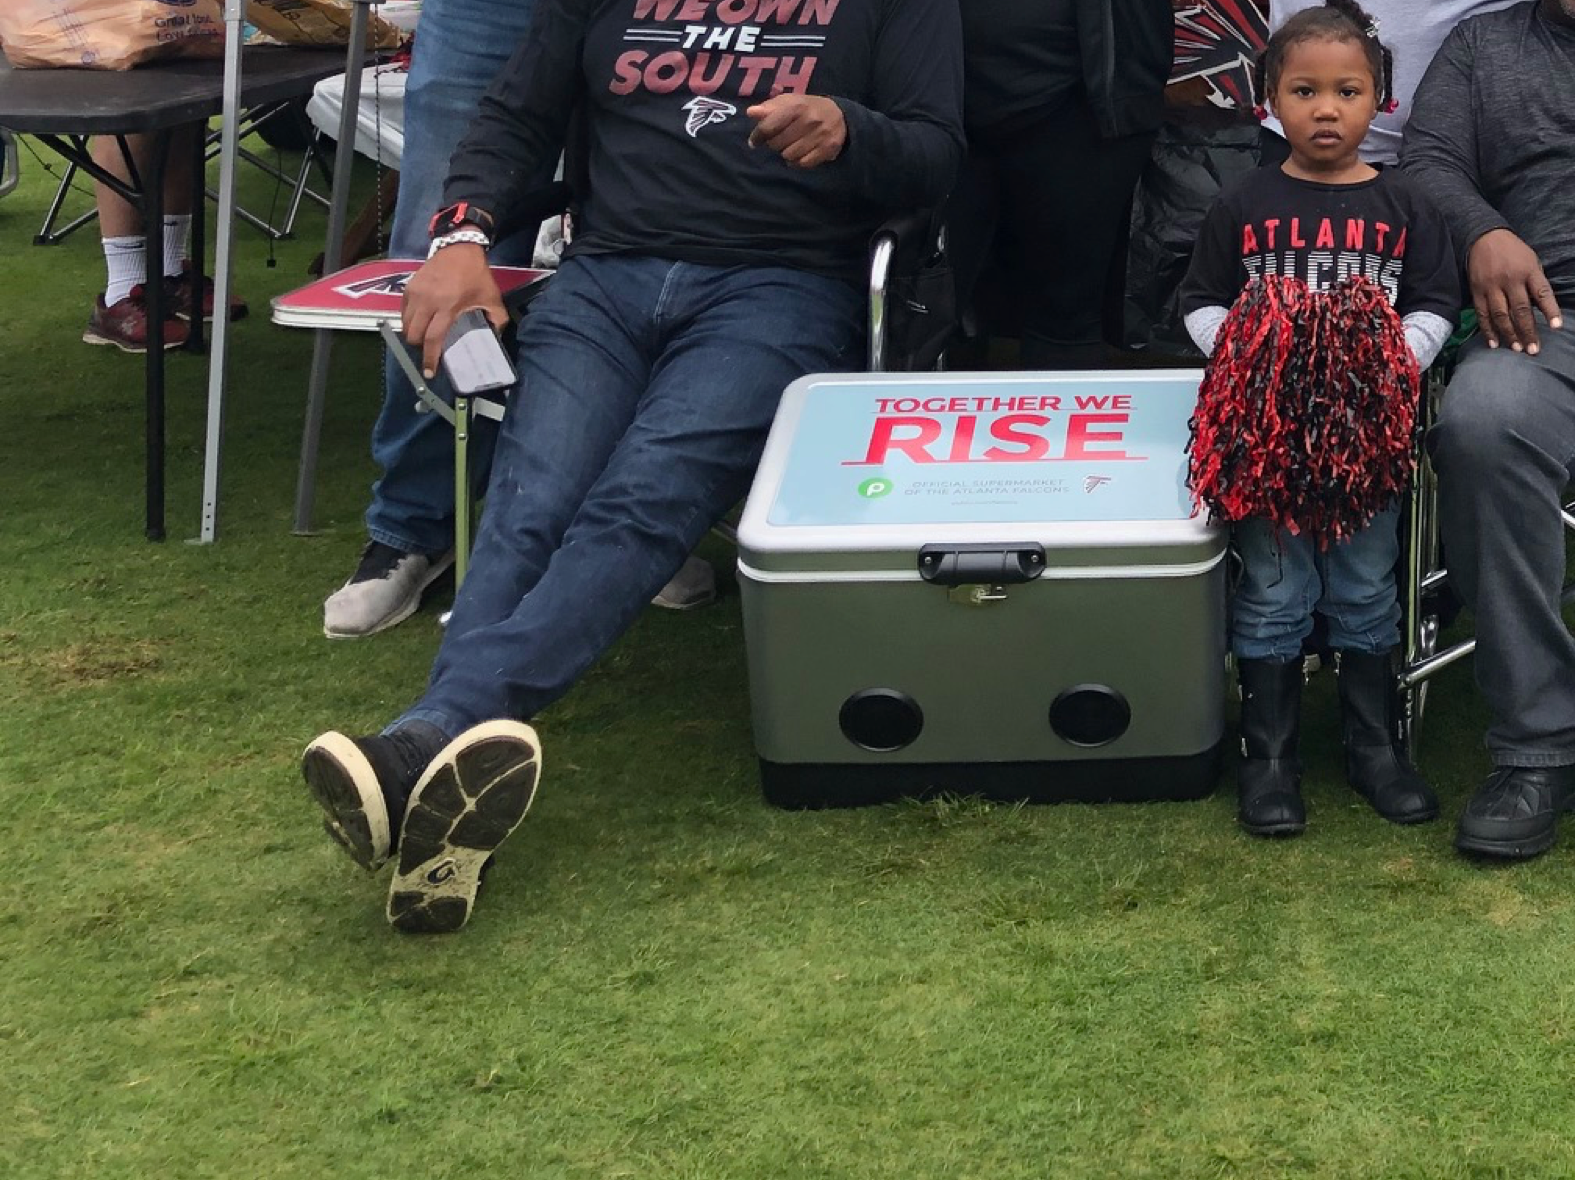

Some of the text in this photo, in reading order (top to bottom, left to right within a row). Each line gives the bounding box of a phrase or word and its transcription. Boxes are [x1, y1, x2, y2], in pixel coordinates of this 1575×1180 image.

[682, 25, 761, 53] THE
[608, 50, 817, 97] SOUTH
[874, 395, 1132, 413] TOGETHER WE
[865, 414, 1129, 464] RISE
[953, 487, 1010, 495] ATLANTA
[1013, 486, 1070, 494] FALCONS
[973, 478, 1065, 488] SUPERMARKET
